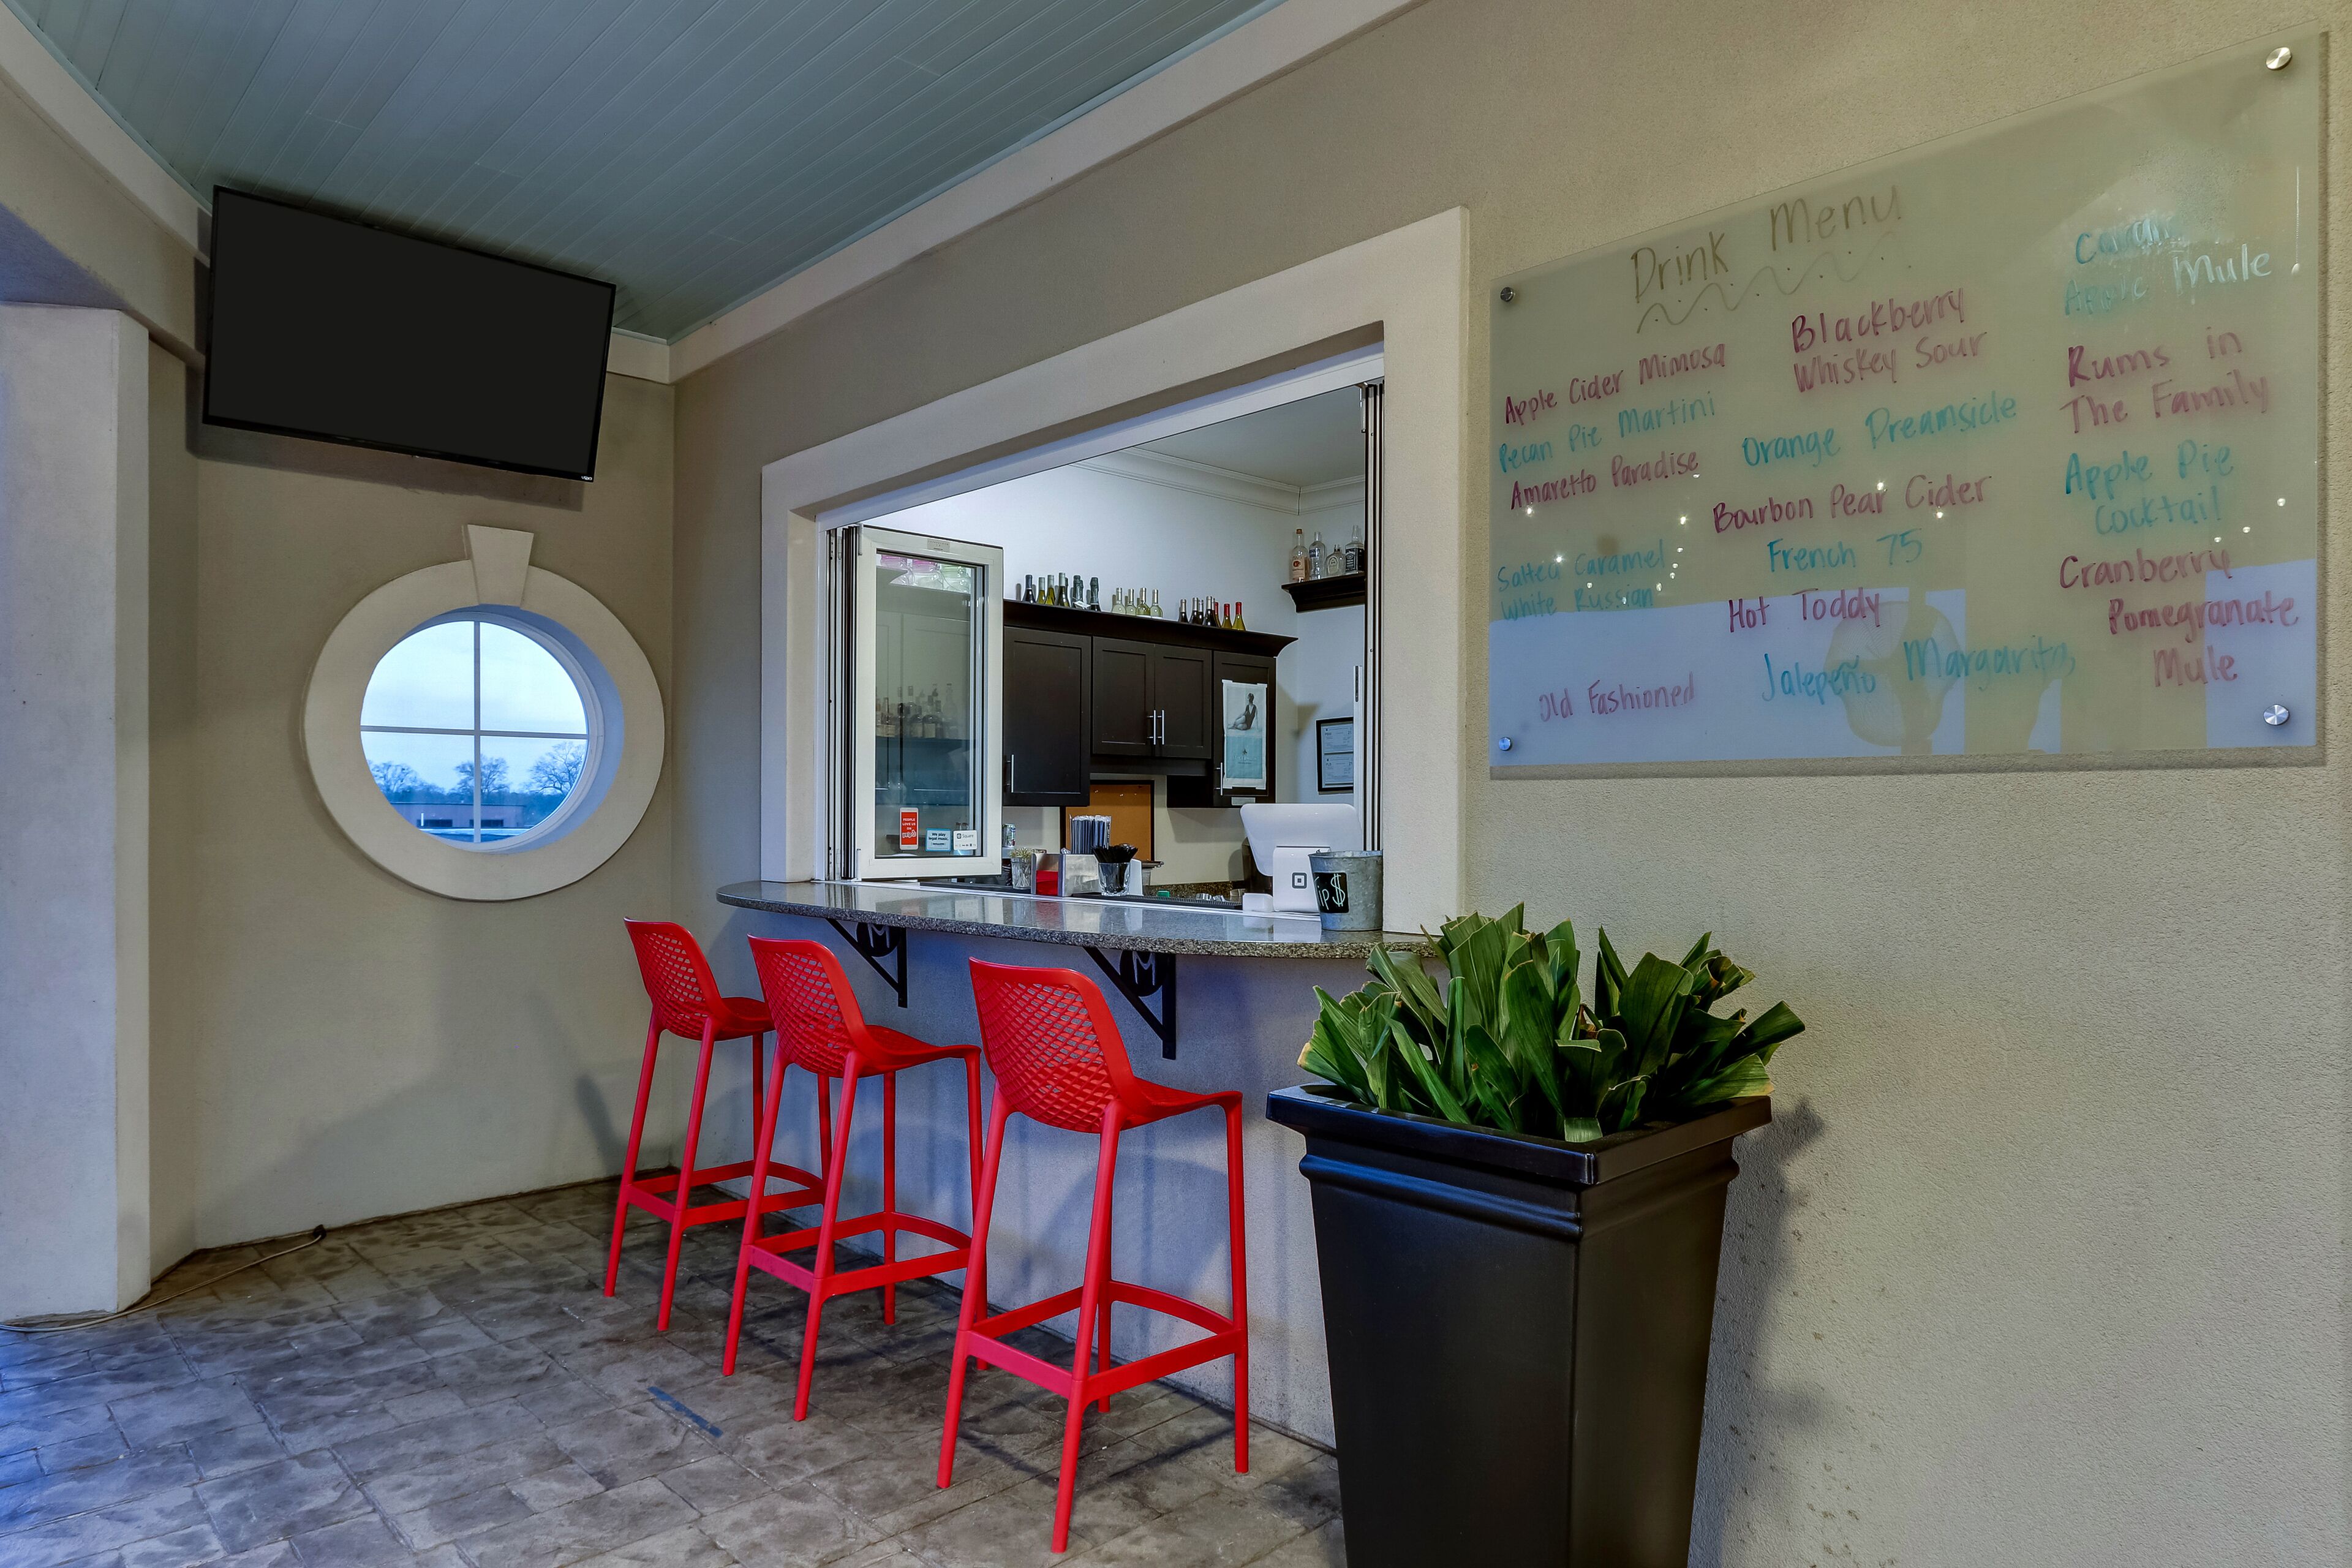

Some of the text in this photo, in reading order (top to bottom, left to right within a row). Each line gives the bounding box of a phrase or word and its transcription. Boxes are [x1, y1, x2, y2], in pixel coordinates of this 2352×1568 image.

[1631, 185, 1901, 303] Drink Menu
[2172, 243, 2272, 295] Mule
[1791, 287, 1965, 353] Blackberry
[1505, 342, 1727, 426] Apple Cider Mimosa
[1793, 331, 1988, 393] Whiskey Sour
[2068, 326, 2243, 388] Rums in
[1741, 390, 2019, 467] Orange Dreamsicle
[2059, 369, 2266, 434] The Family
[1499, 390, 1716, 472] Pecan Pie Martini
[1510, 450, 1699, 510] Amaretto Paradise
[2065, 439, 2234, 500] Apple Pie
[1714, 473, 1992, 533] Bourbon Pear Cider
[2095, 485, 2222, 535] Cocktail
[1574, 538, 1666, 576] Caramel
[1766, 527, 1923, 573] French 75
[2060, 548, 2233, 589] Cranberry
[1501, 584, 1654, 621] White Russian
[1728, 587, 1881, 633] Hot Toddy
[2109, 590, 2299, 643] Pomegranate
[1588, 671, 1695, 715] Fashioned
[2154, 645, 2237, 687] Mule
[1330, 873, 1345, 907] $
